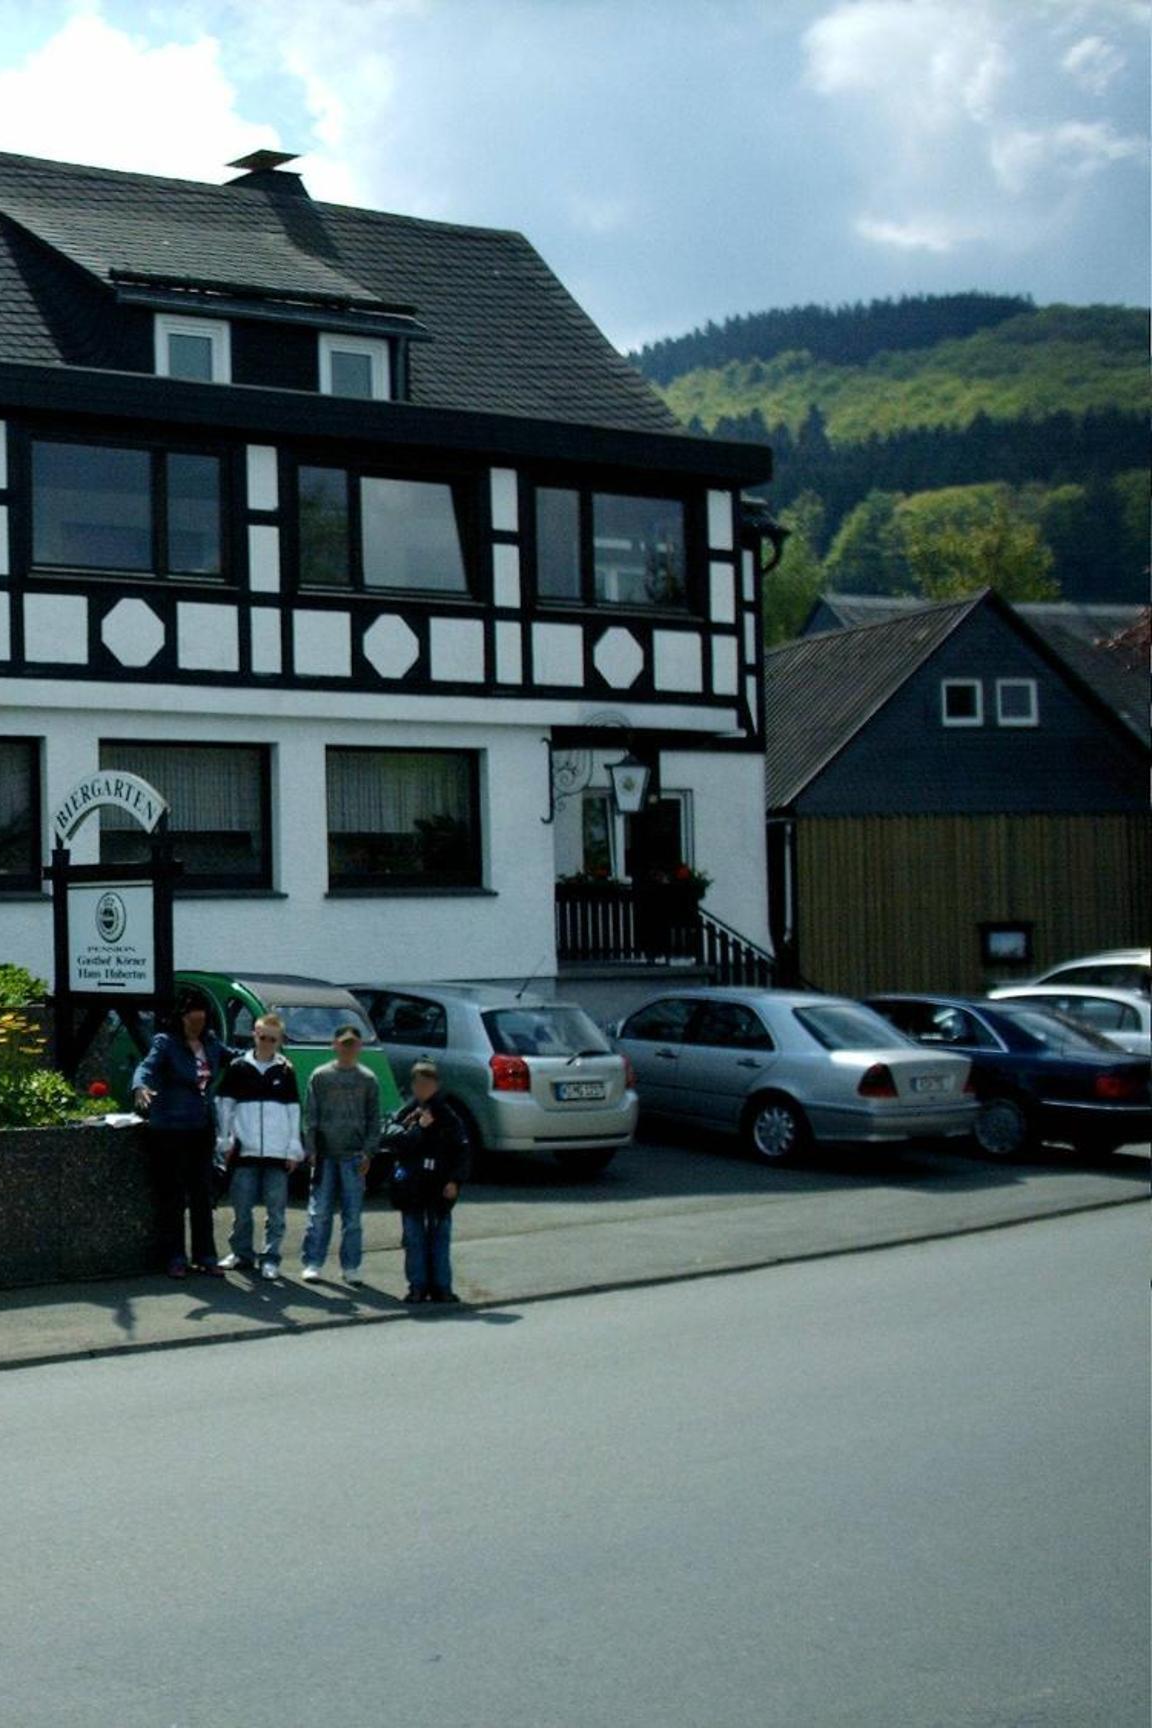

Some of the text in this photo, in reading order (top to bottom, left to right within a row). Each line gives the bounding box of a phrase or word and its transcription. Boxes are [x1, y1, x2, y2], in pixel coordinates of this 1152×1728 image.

[56, 778, 155, 829] BIERGARTEN
[76, 955, 148, 966] Gasthof Körner
[105, 968, 148, 980] Hubertus
